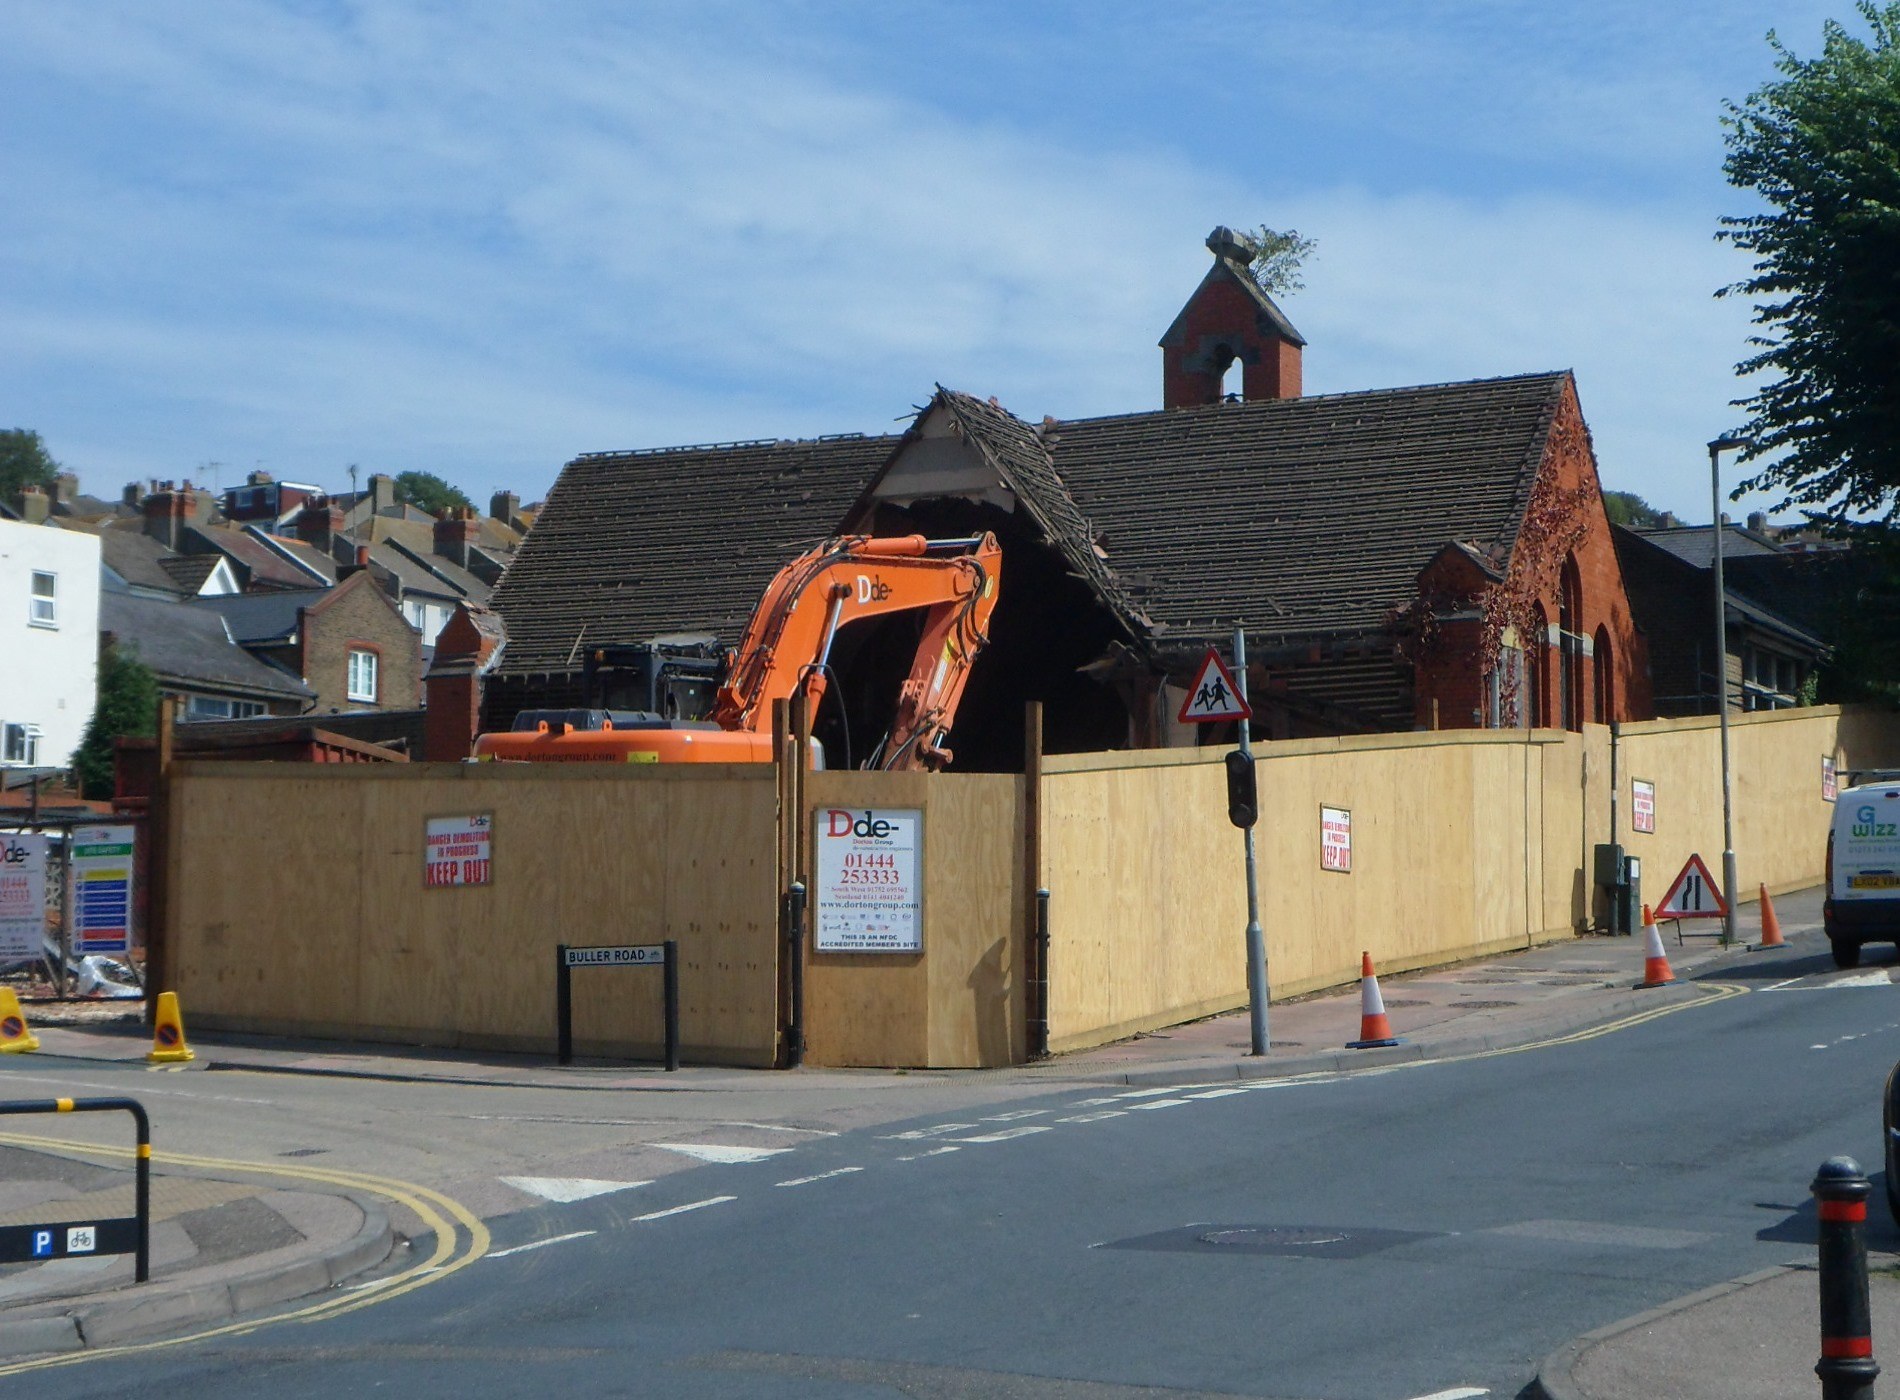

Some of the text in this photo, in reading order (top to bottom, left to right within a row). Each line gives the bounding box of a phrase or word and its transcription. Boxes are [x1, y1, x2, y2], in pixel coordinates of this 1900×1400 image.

[428, 831, 490, 845] DANGER DEMOLITION
[438, 845, 478, 857] IN PROGRESS
[1322, 845, 1350, 868] KEEP OUT
[845, 853, 894, 868] 01444
[427, 859, 490, 885] KEEP OUT
[840, 869, 899, 884] 253333
[820, 901, 919, 911] www.dortongroup.com
[569, 949, 645, 963] BULLER ROAD
[36, 1231, 51, 1254] P
